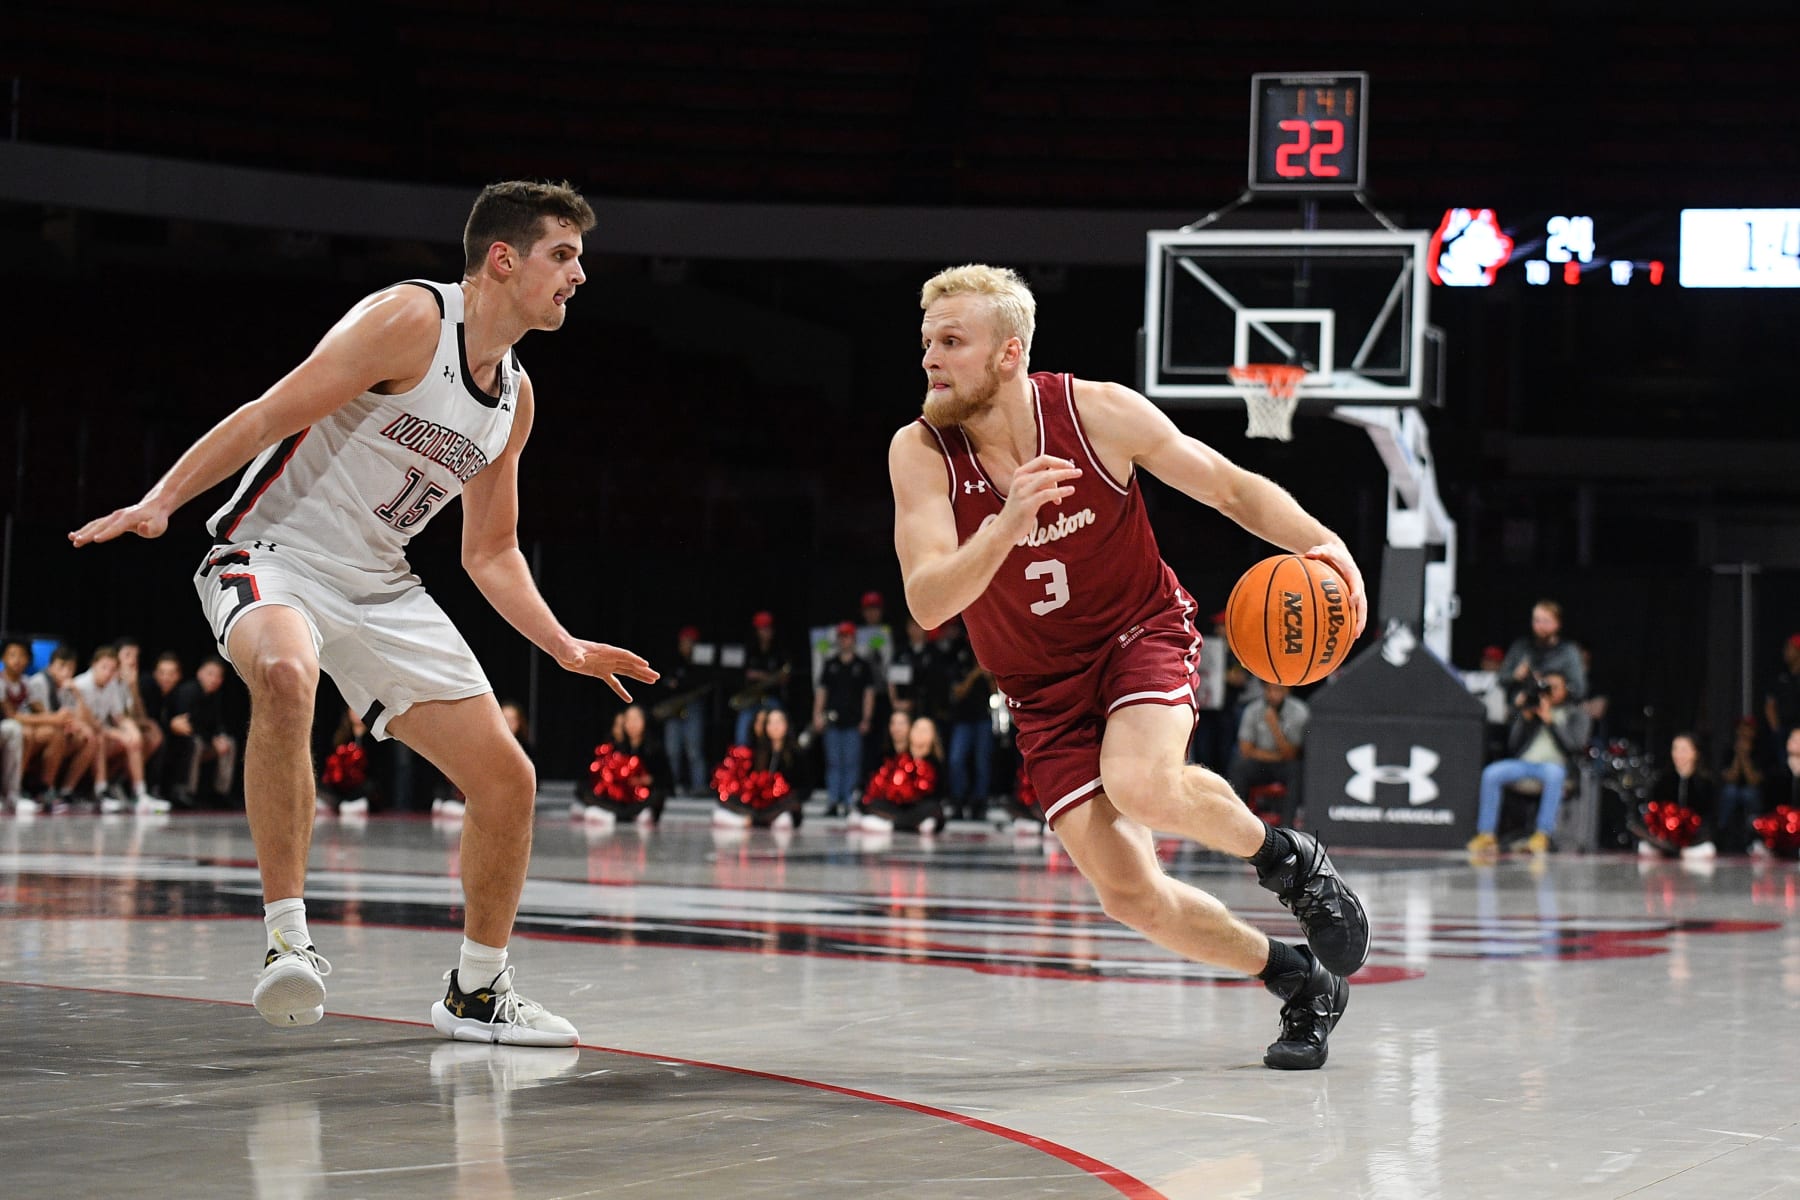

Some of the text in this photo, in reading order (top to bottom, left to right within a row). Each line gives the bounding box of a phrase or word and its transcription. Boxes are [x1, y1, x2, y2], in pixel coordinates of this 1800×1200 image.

[1276, 120, 1344, 177] 22
[1547, 216, 1595, 263] 24
[374, 466, 448, 529] 15
[975, 508, 1096, 547] leston
[1025, 559, 1070, 616] 3
[1284, 592, 1302, 655] NCAA
[1319, 579, 1344, 664] Wilson
